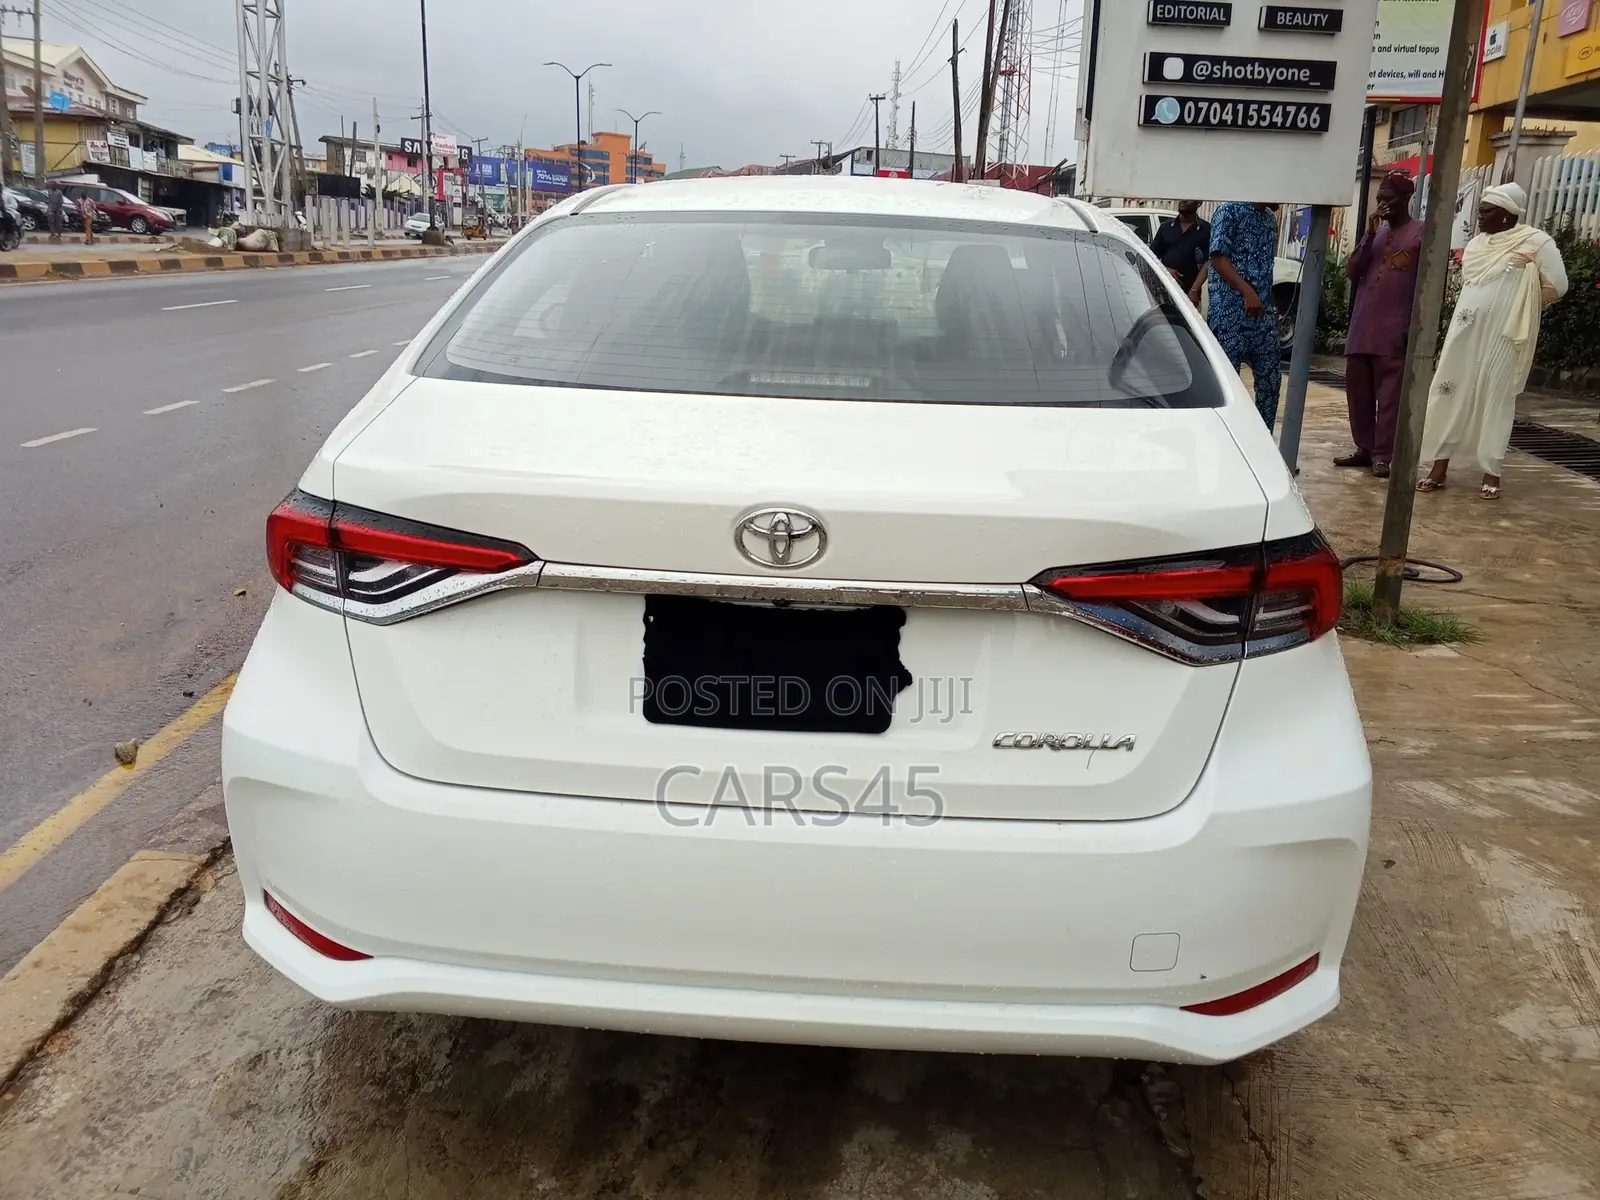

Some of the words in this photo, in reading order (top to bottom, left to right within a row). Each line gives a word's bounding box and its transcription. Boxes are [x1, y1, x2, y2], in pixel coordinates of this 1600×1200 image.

[1156, 4, 1227, 21] EDITORIAL
[1276, 11, 1329, 27] BEAUTY
[1377, 44, 1392, 53] and
[1393, 44, 1417, 53] virtual
[1418, 45, 1440, 55] topup
[1192, 60, 1321, 86] @shotbyone_
[1377, 69, 1406, 79] devices,
[1407, 69, 1421, 78] wifi
[1422, 70, 1437, 78] and
[1184, 101, 1321, 129] 07041554766
[992, 731, 1136, 752] COROLLA
